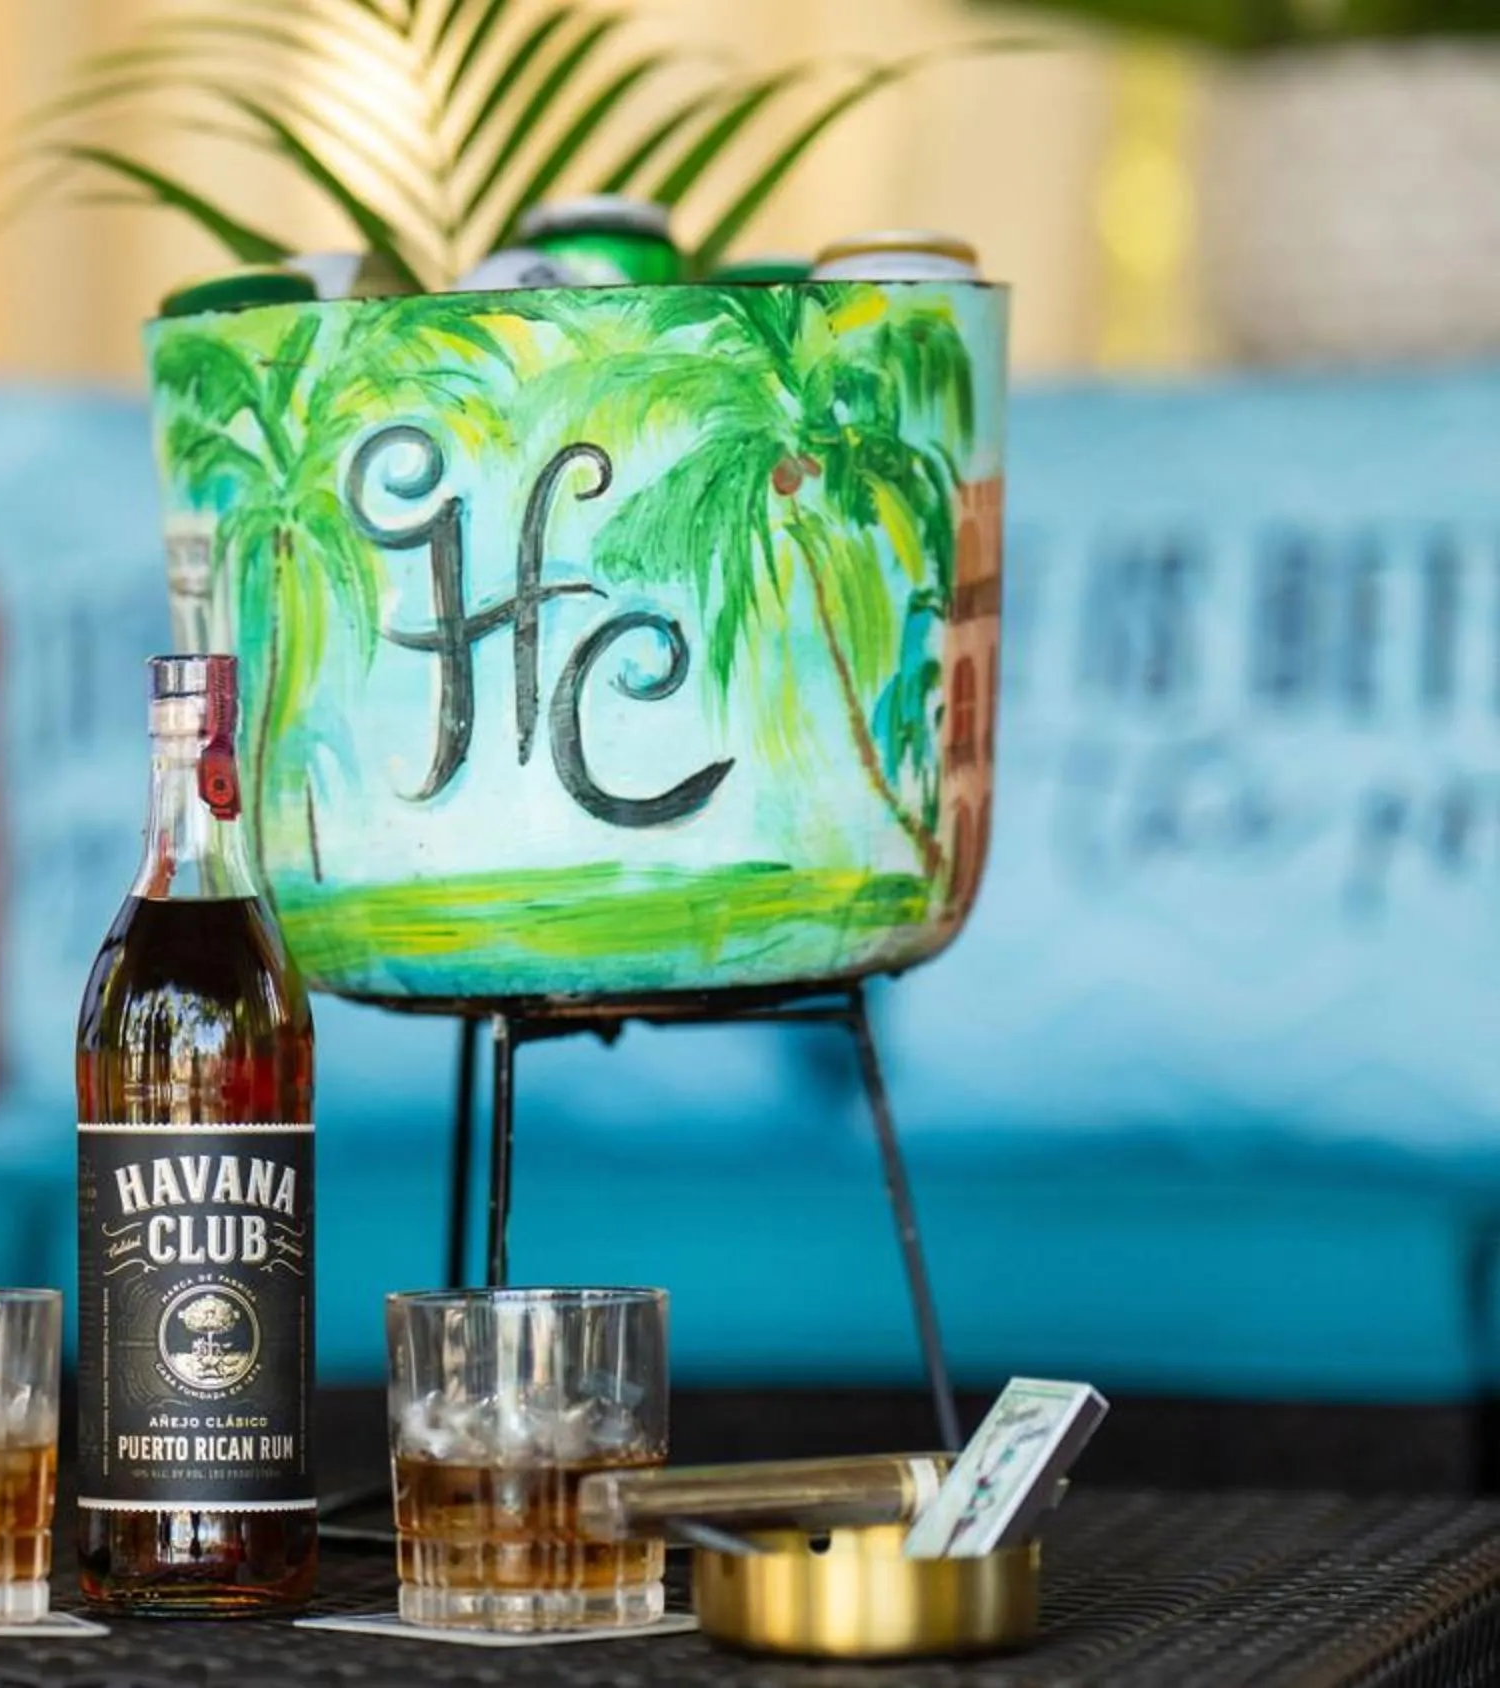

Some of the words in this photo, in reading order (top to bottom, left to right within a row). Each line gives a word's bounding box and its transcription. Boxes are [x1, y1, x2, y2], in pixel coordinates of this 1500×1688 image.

[114, 1155, 297, 1216] HAVANA
[147, 1215, 269, 1265] CLUB
[149, 1413, 200, 1429] AÑEJO
[205, 1413, 269, 1429] CLÁSICO
[118, 1435, 188, 1461] PUERTO
[194, 1435, 254, 1461] RICAN
[260, 1435, 294, 1461] RUM
